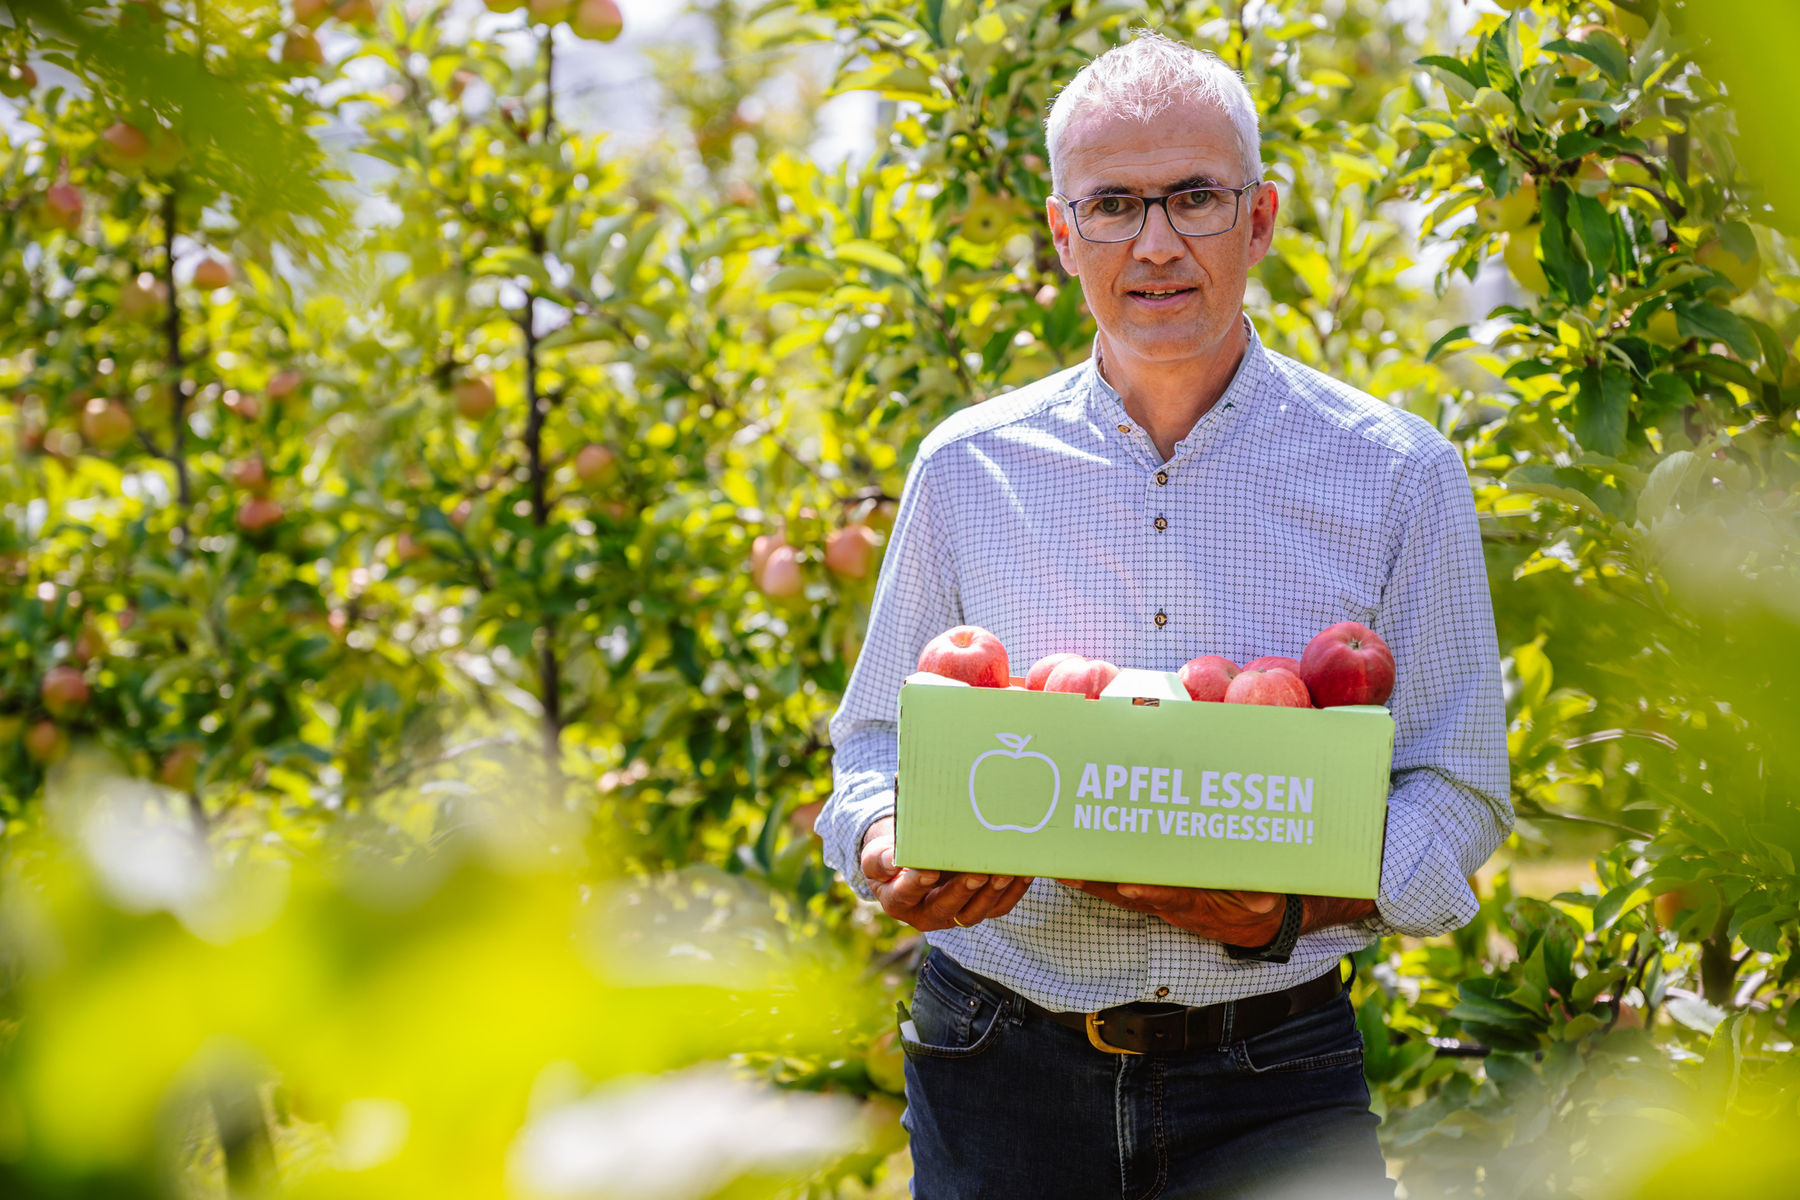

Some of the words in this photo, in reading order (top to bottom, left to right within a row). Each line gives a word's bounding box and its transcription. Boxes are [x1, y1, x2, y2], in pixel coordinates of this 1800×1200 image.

[1076, 762, 1190, 805] APFEL
[1200, 770, 1314, 813] ESSEN
[1073, 804, 1153, 834] NICHT
[1157, 809, 1314, 844] VERGESSEN!
